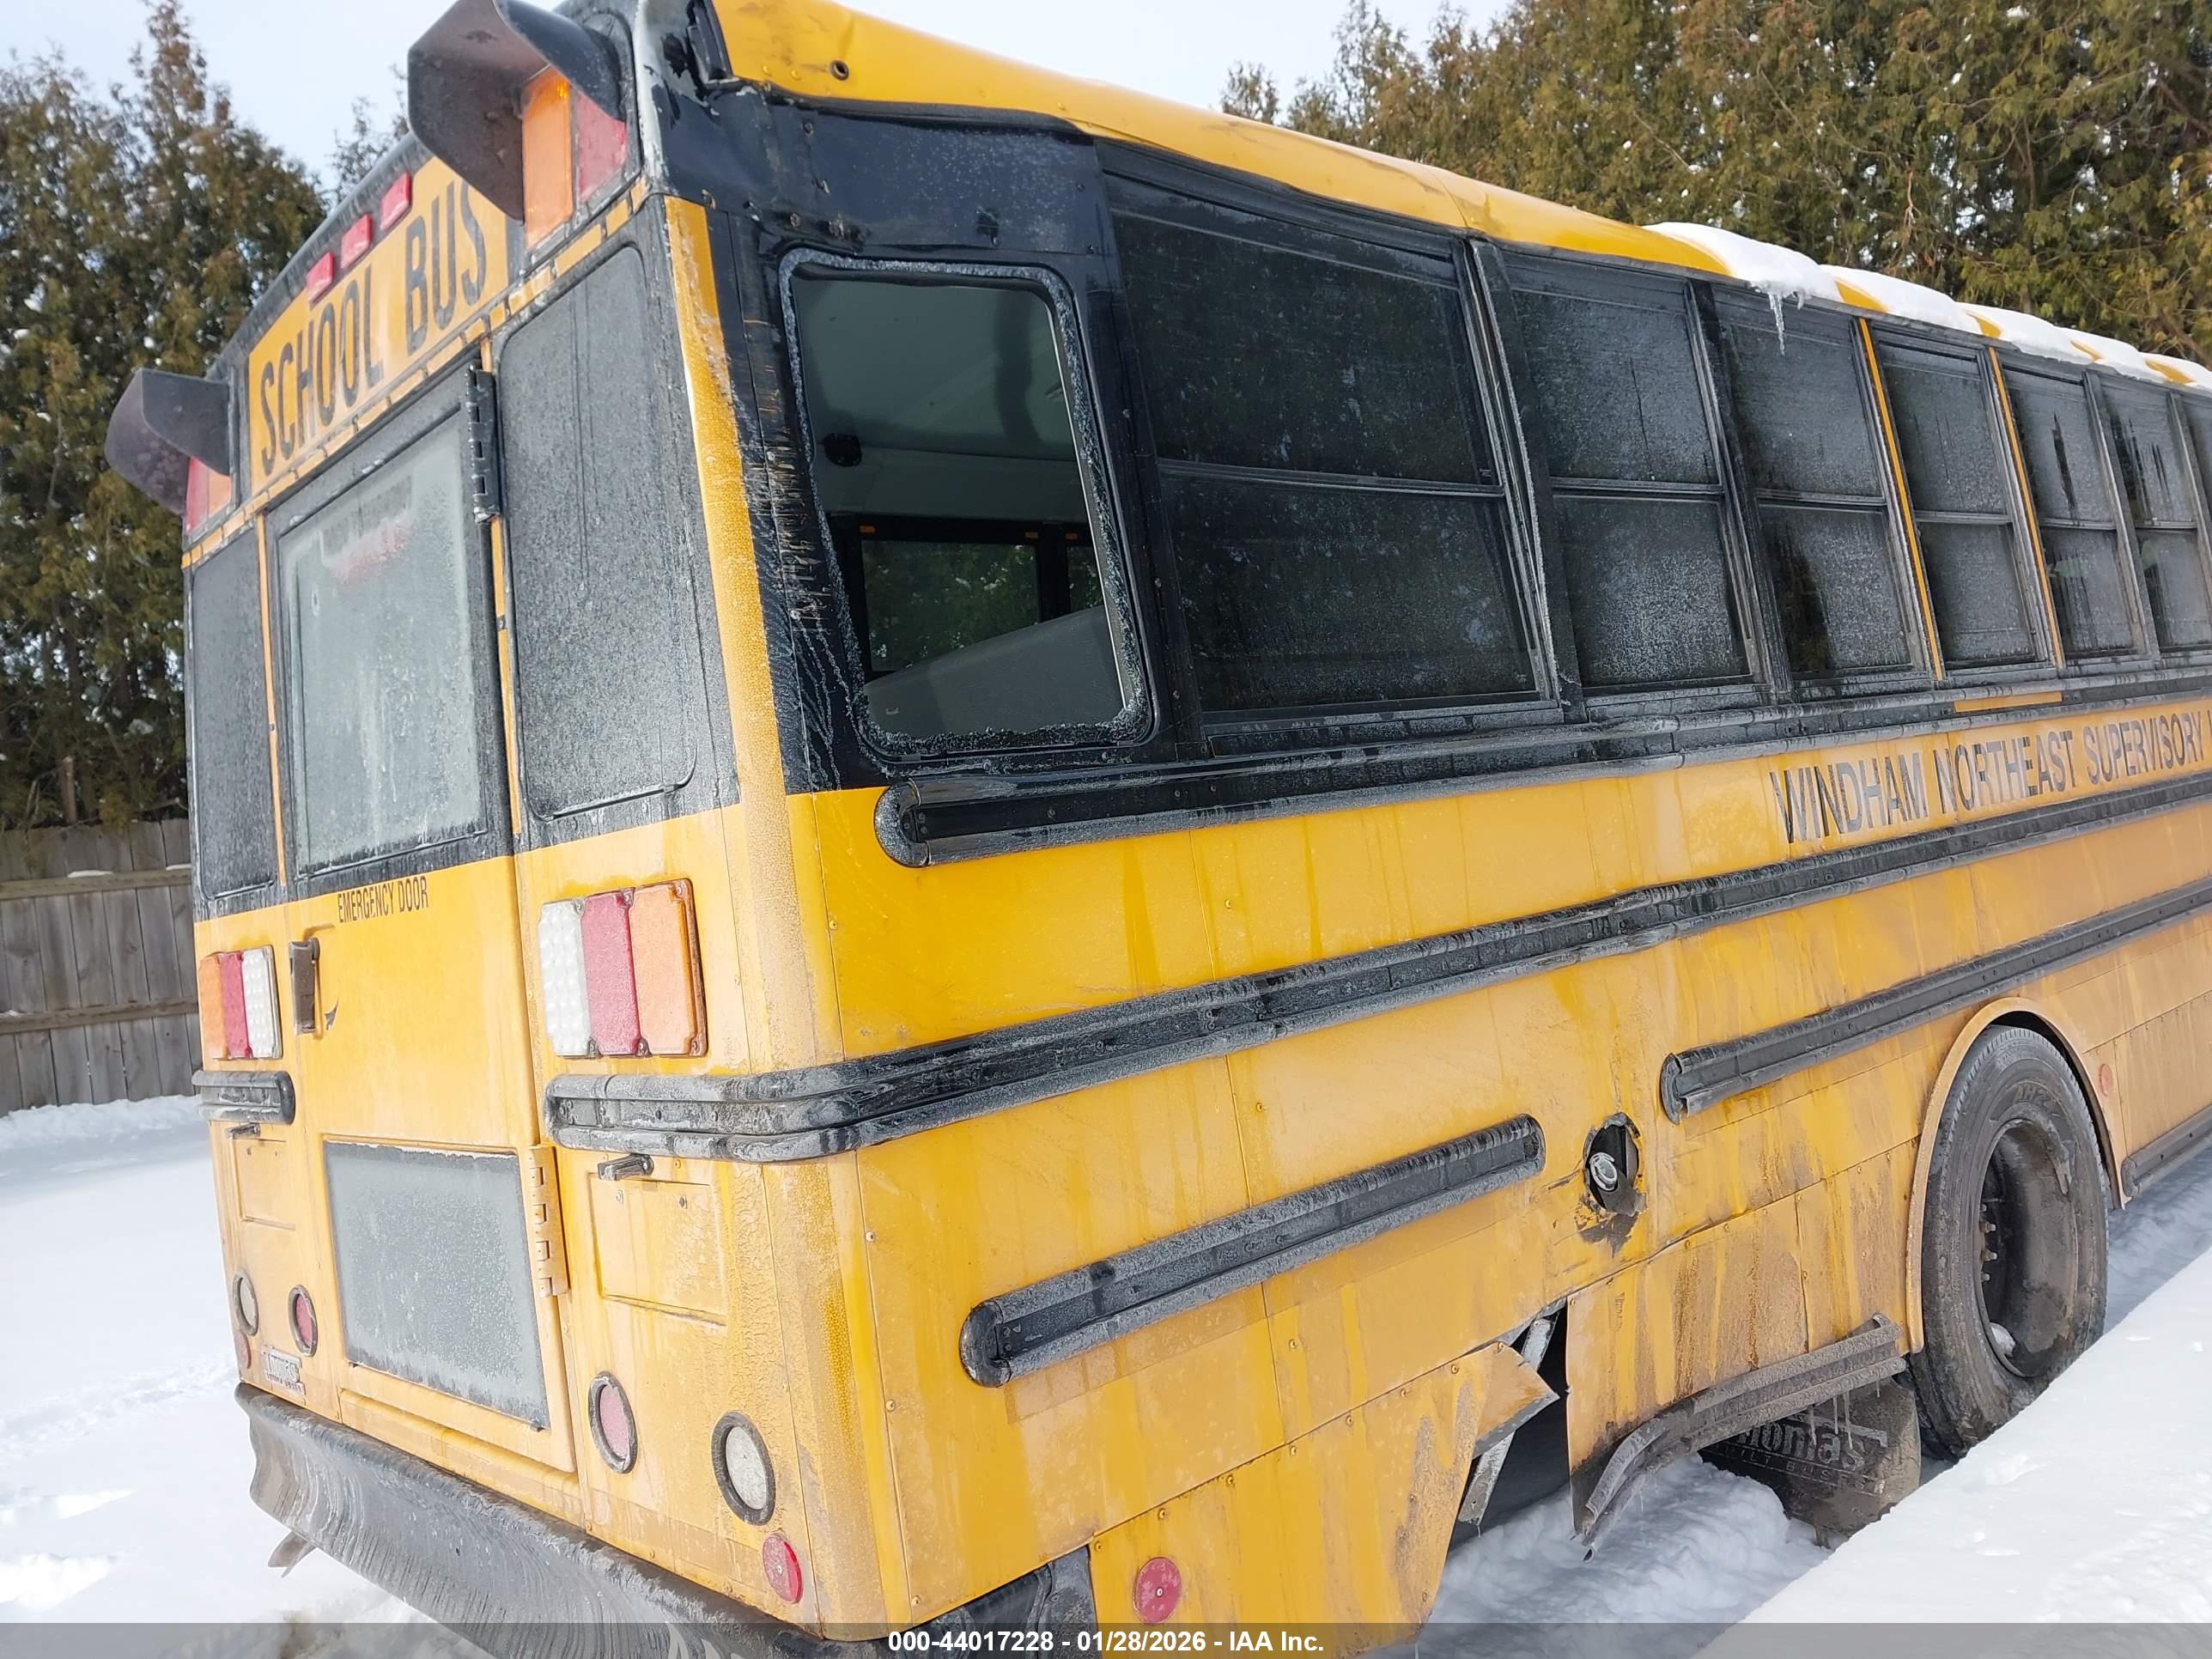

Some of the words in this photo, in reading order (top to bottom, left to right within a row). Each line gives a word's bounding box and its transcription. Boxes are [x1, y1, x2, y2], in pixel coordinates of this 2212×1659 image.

[260, 264, 385, 476] SCHOOL
[405, 180, 486, 356] BUS
[1769, 751, 1929, 843] WINDHAM
[1933, 729, 2078, 814] NORTHEAST
[2082, 710, 2204, 785] SUPERVISORY
[337, 882, 395, 923] EMERGENCY
[398, 875, 428, 913] DOOR
